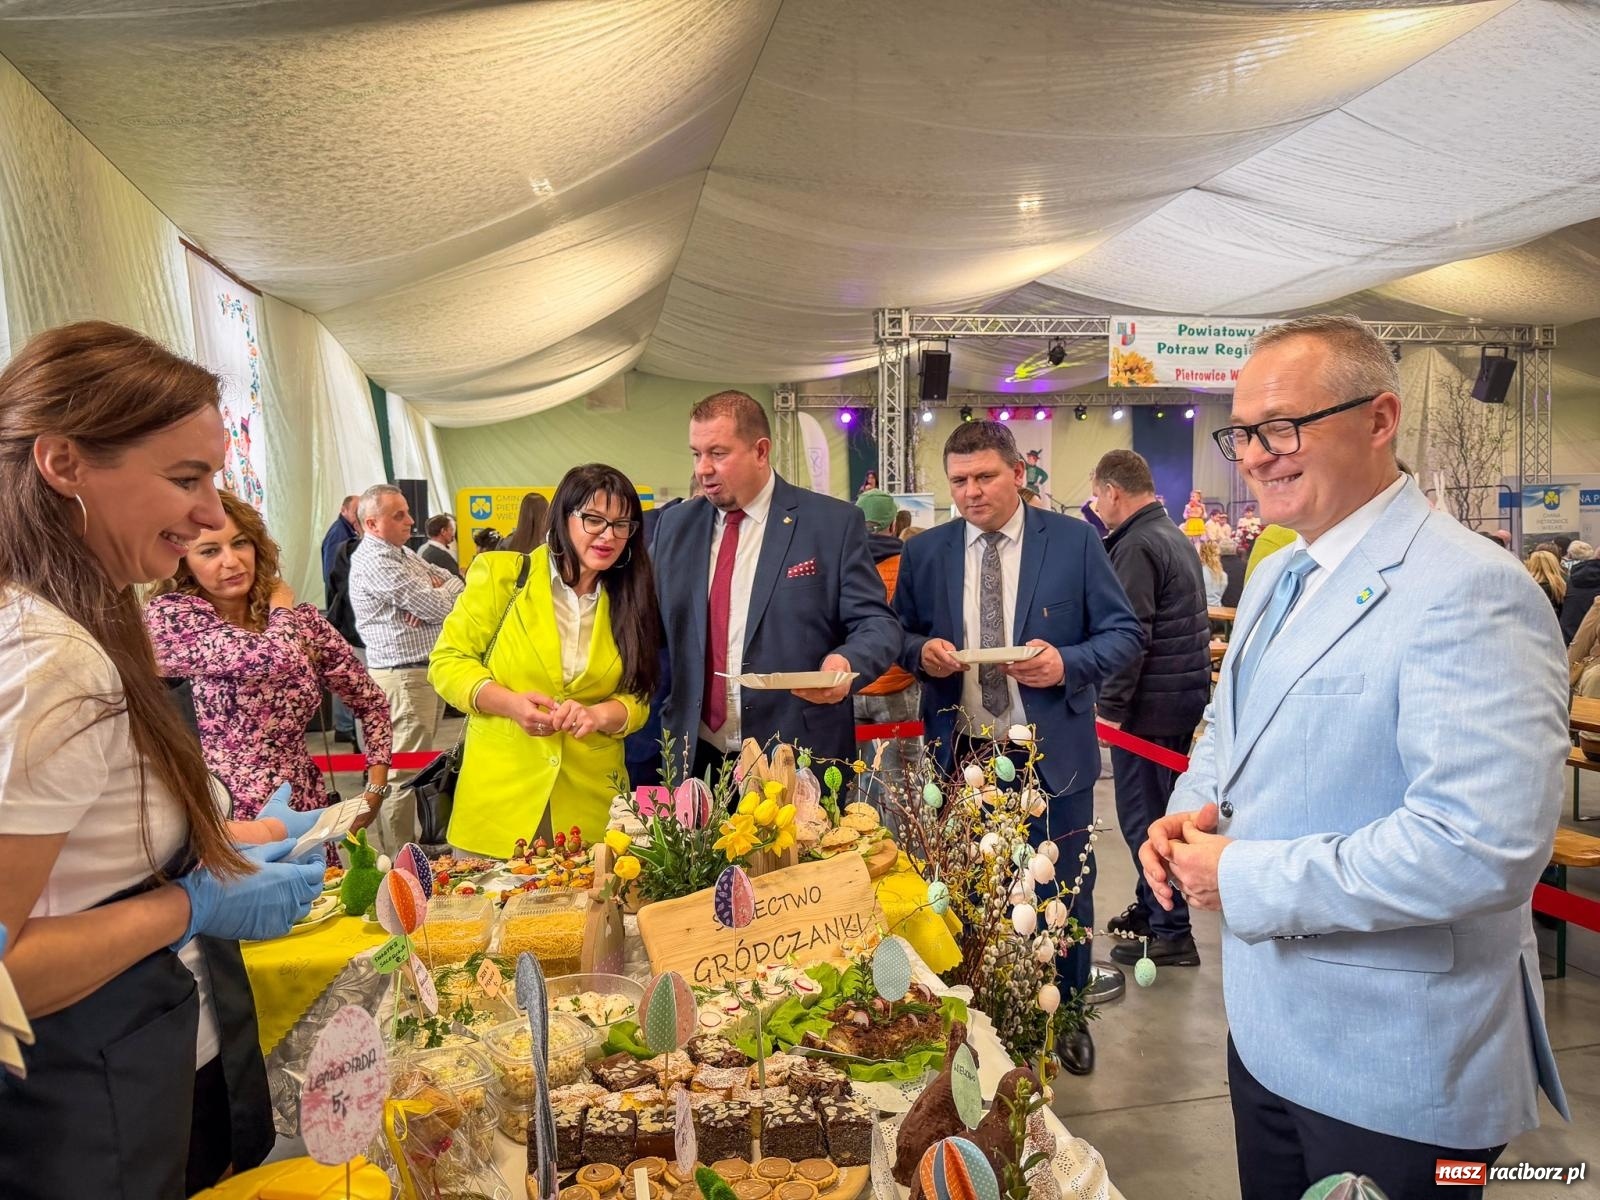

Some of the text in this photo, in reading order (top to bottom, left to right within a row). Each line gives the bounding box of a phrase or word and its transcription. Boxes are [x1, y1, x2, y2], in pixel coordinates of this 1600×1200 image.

[1178, 324, 1256, 338] Powiatowy
[1157, 342, 1209, 356] Potraw
[1175, 368, 1226, 381] Pietrowice
[712, 885, 822, 932] SECTWO
[693, 912, 863, 984] GRÓDCZANKI
